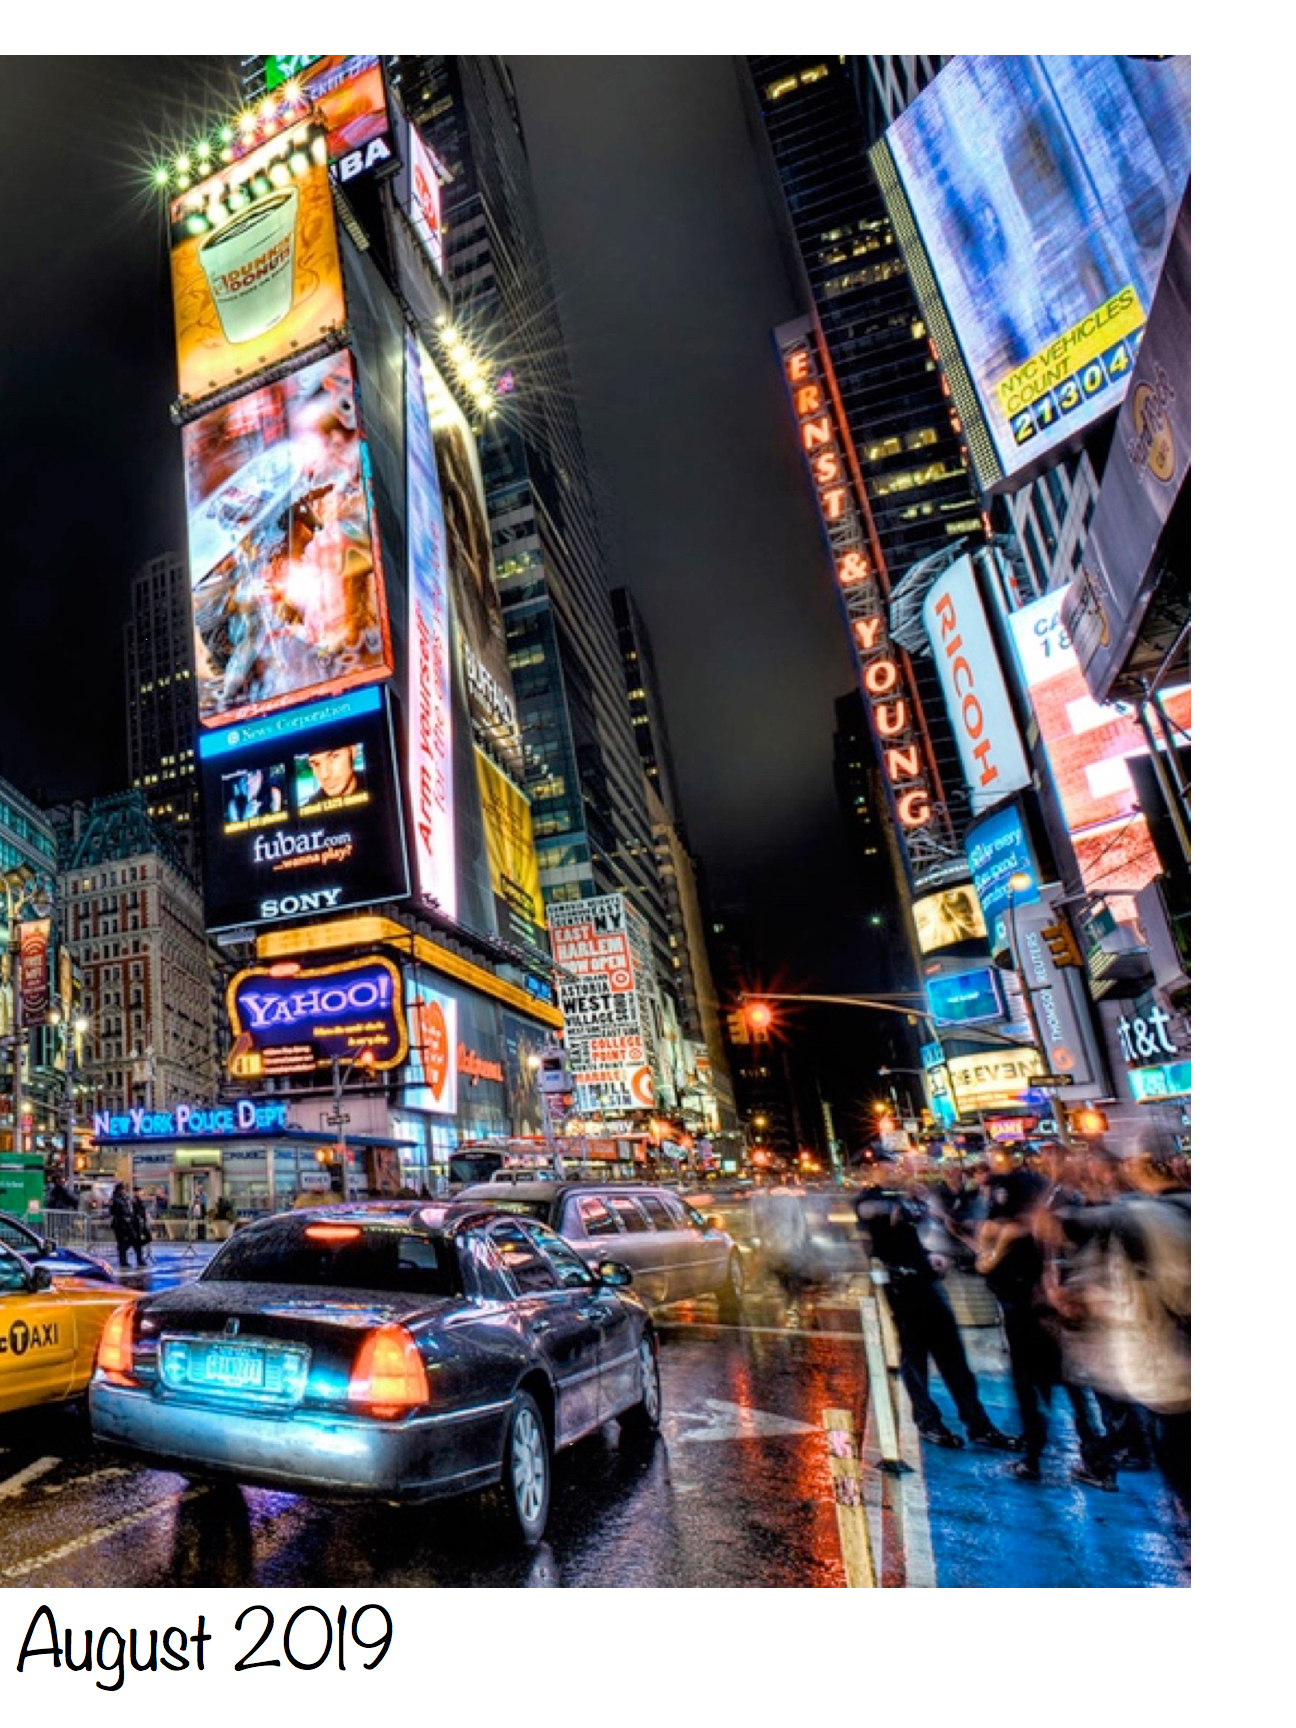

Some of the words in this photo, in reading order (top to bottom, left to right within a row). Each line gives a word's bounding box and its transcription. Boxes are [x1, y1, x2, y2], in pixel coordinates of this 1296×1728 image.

[1001, 360, 1037, 396] NYC
[1040, 289, 1134, 367] VEHICLES
[1006, 356, 1071, 414] COUNT
[788, 350, 846, 520] ERNST
[838, 551, 869, 584] &
[854, 618, 932, 827] YOUNG
[933, 591, 1000, 789] RICOH
[275, 702, 352, 730] Corporation
[416, 763, 435, 857] Arm
[253, 829, 353, 863] fubar.com
[260, 887, 343, 918] SONY
[554, 925, 591, 943] EAST
[557, 937, 624, 962] HARLEM
[591, 953, 627, 971] OPEN
[239, 975, 390, 1028] YAHOO!
[564, 995, 612, 1014] WEST
[565, 1011, 614, 1027] VILLAGE
[591, 1035, 642, 1050] COLLEGE
[591, 1049, 627, 1062] POINT
[93, 1110, 131, 1137] NEW
[129, 1107, 175, 1135] YORK
[176, 1103, 235, 1134] POLICE
[236, 1098, 286, 1130] DEPT
[9, 1319, 60, 1356] TAXI
